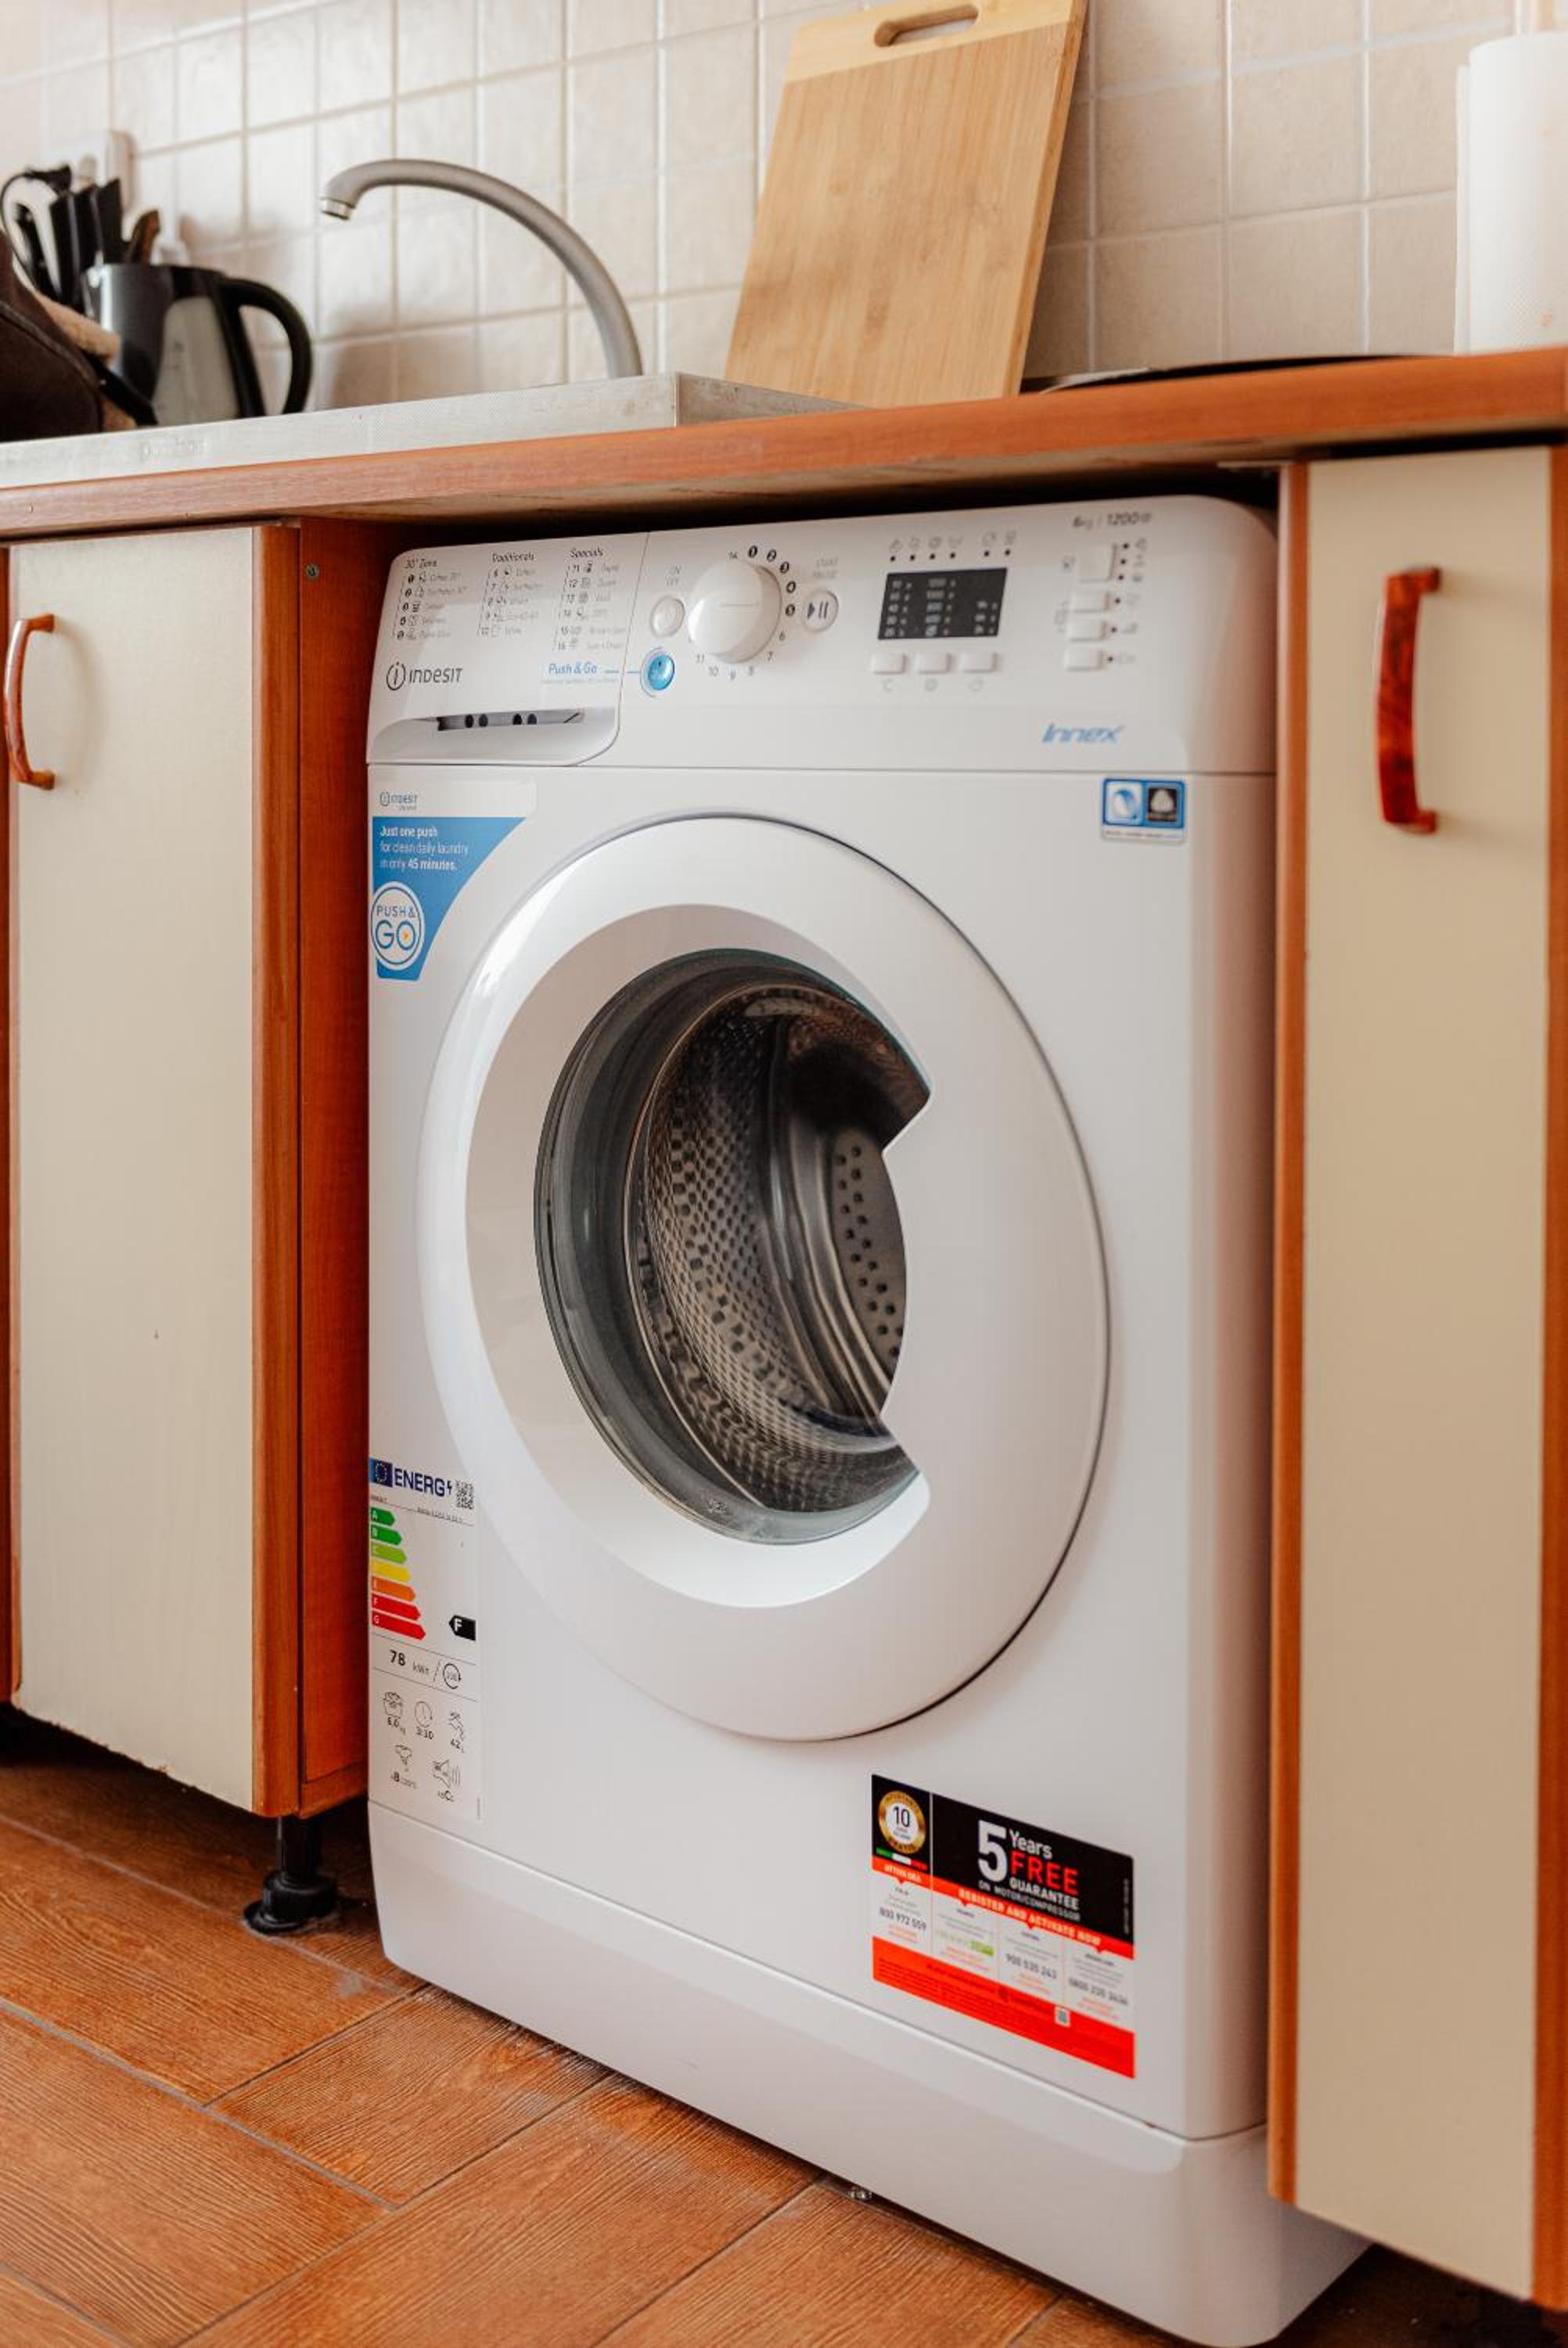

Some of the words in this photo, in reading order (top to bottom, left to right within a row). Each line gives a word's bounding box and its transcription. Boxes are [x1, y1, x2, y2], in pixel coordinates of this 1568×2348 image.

[548, 663, 573, 674] Push
[574, 662, 581, 674] &
[583, 661, 598, 674] Go
[1041, 722, 1127, 744] Innex
[380, 826, 398, 836] Just
[400, 828, 416, 837] one
[417, 826, 438, 839] push
[379, 841, 390, 852] for
[392, 842, 414, 854] clean
[415, 842, 437, 856] daily
[437, 842, 469, 856] laundry
[389, 859, 406, 872] only
[408, 858, 419, 870] 45
[420, 858, 458, 871] minutes.
[376, 905, 406, 918] PUSH
[408, 906, 416, 918] &
[376, 920, 415, 950] GO
[394, 1468, 445, 1497] ENERG
[454, 1618, 462, 1632] F
[390, 1649, 406, 1666] 78
[894, 1806, 910, 1828] 10
[978, 1819, 1008, 1882] 5
[1009, 1828, 1052, 1860] Years
[1009, 1849, 1078, 1896] FREE
[978, 1880, 991, 1892] ON
[1009, 1877, 1080, 1910] GUARANTEE
[958, 1888, 1005, 1913] REGISTER
[1005, 1905, 1027, 1920] AND
[1027, 1910, 1076, 1939] ACTIVATE
